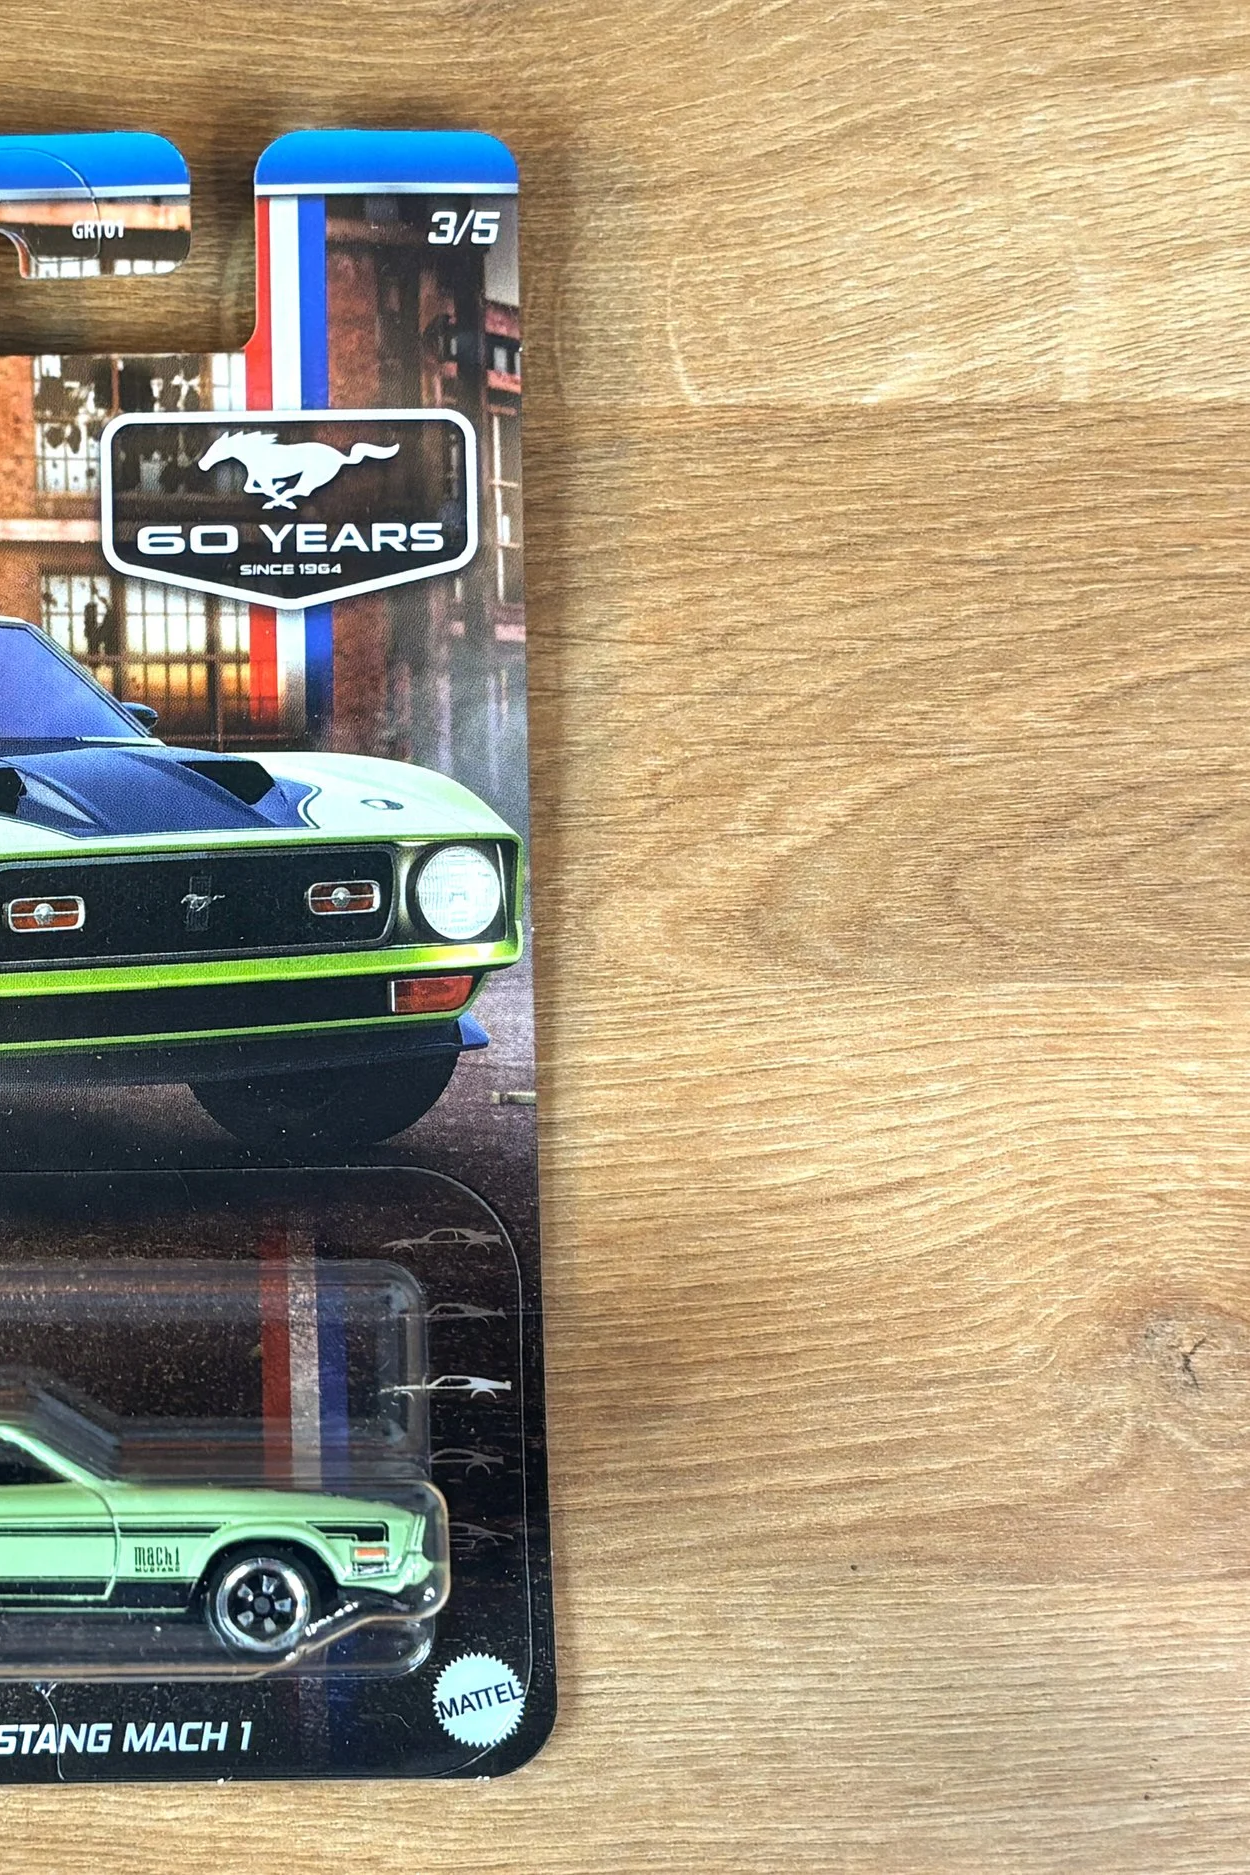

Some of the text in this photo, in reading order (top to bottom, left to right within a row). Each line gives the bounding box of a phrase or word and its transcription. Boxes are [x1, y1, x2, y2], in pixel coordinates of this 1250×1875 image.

[428, 209, 501, 246] 3/5
[137, 522, 444, 555] 60 YEARS
[240, 563, 342, 576] SINCE 1964
[437, 1681, 525, 1721] MATTEL
[122, 1721, 233, 1753] MACH
[239, 1721, 252, 1751] 1
